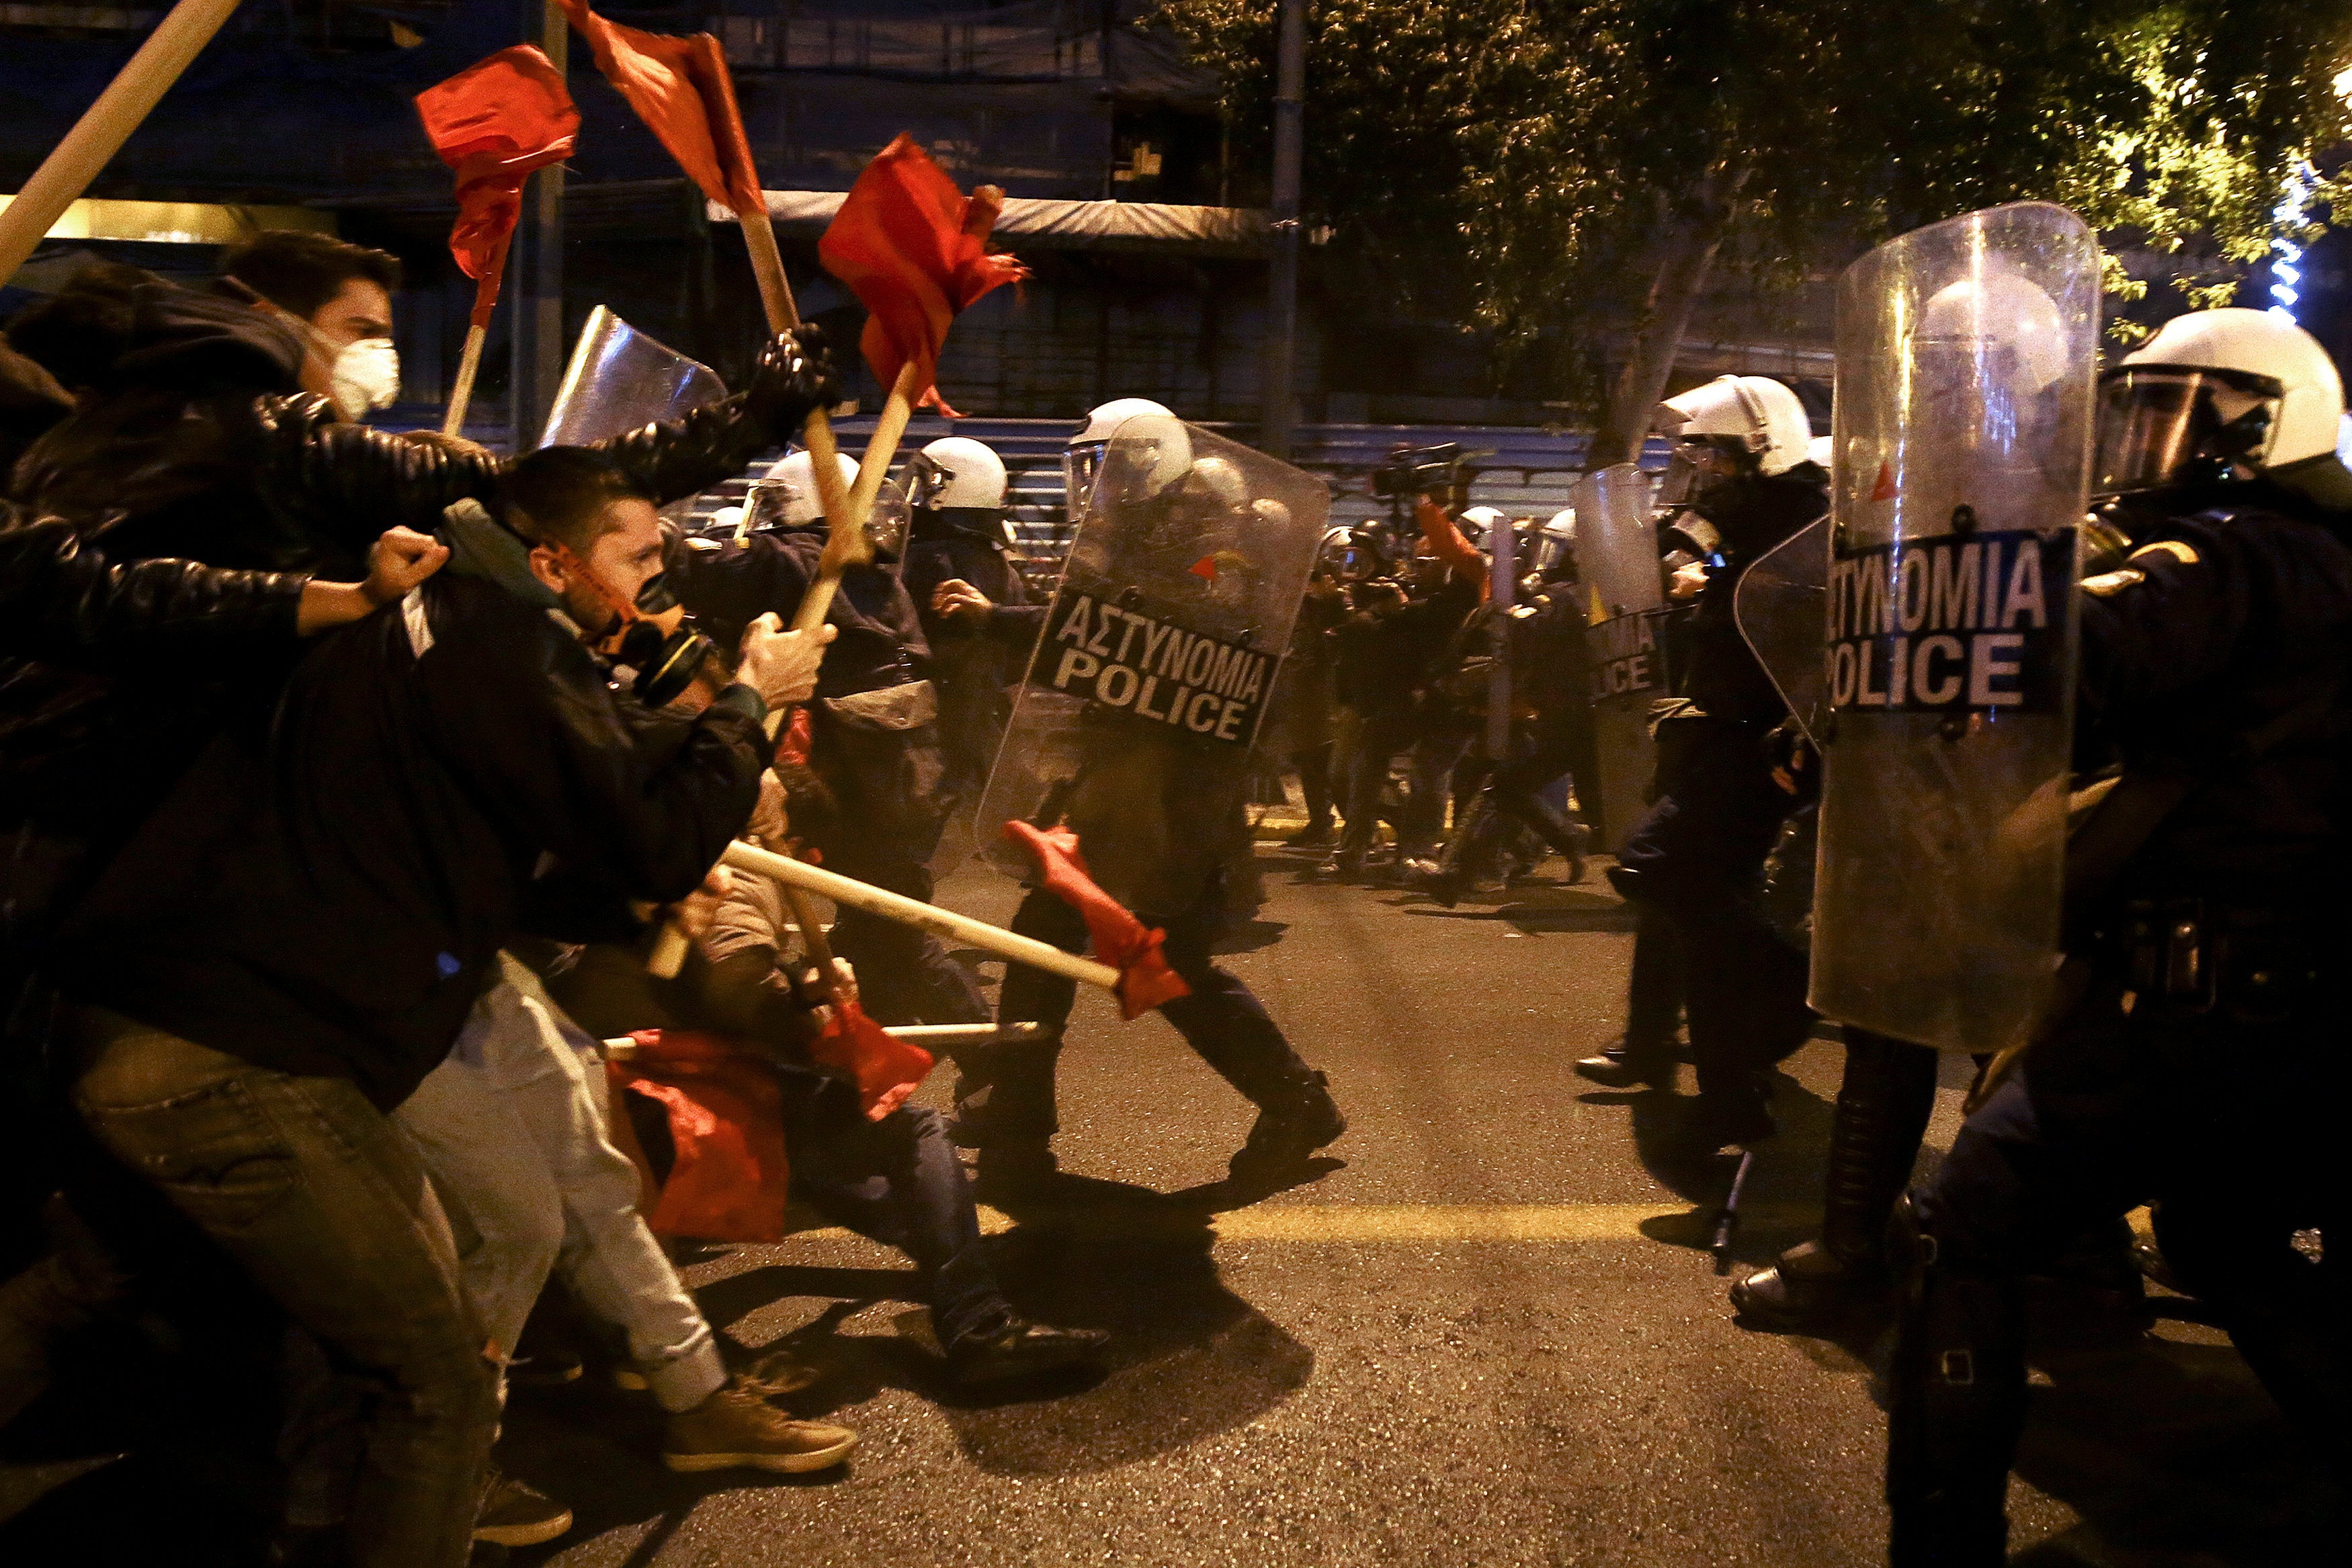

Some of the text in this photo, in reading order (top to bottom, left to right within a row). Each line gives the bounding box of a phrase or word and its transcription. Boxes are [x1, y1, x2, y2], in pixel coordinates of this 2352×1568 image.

[1827, 541, 2046, 640] ΤΥΝΟΜΙΑ
[1054, 648, 1246, 740] POLICE
[1057, 596, 1265, 703] ΑΣΤΥΝΟΜΙΑ
[1827, 633, 2024, 707] OLICE
